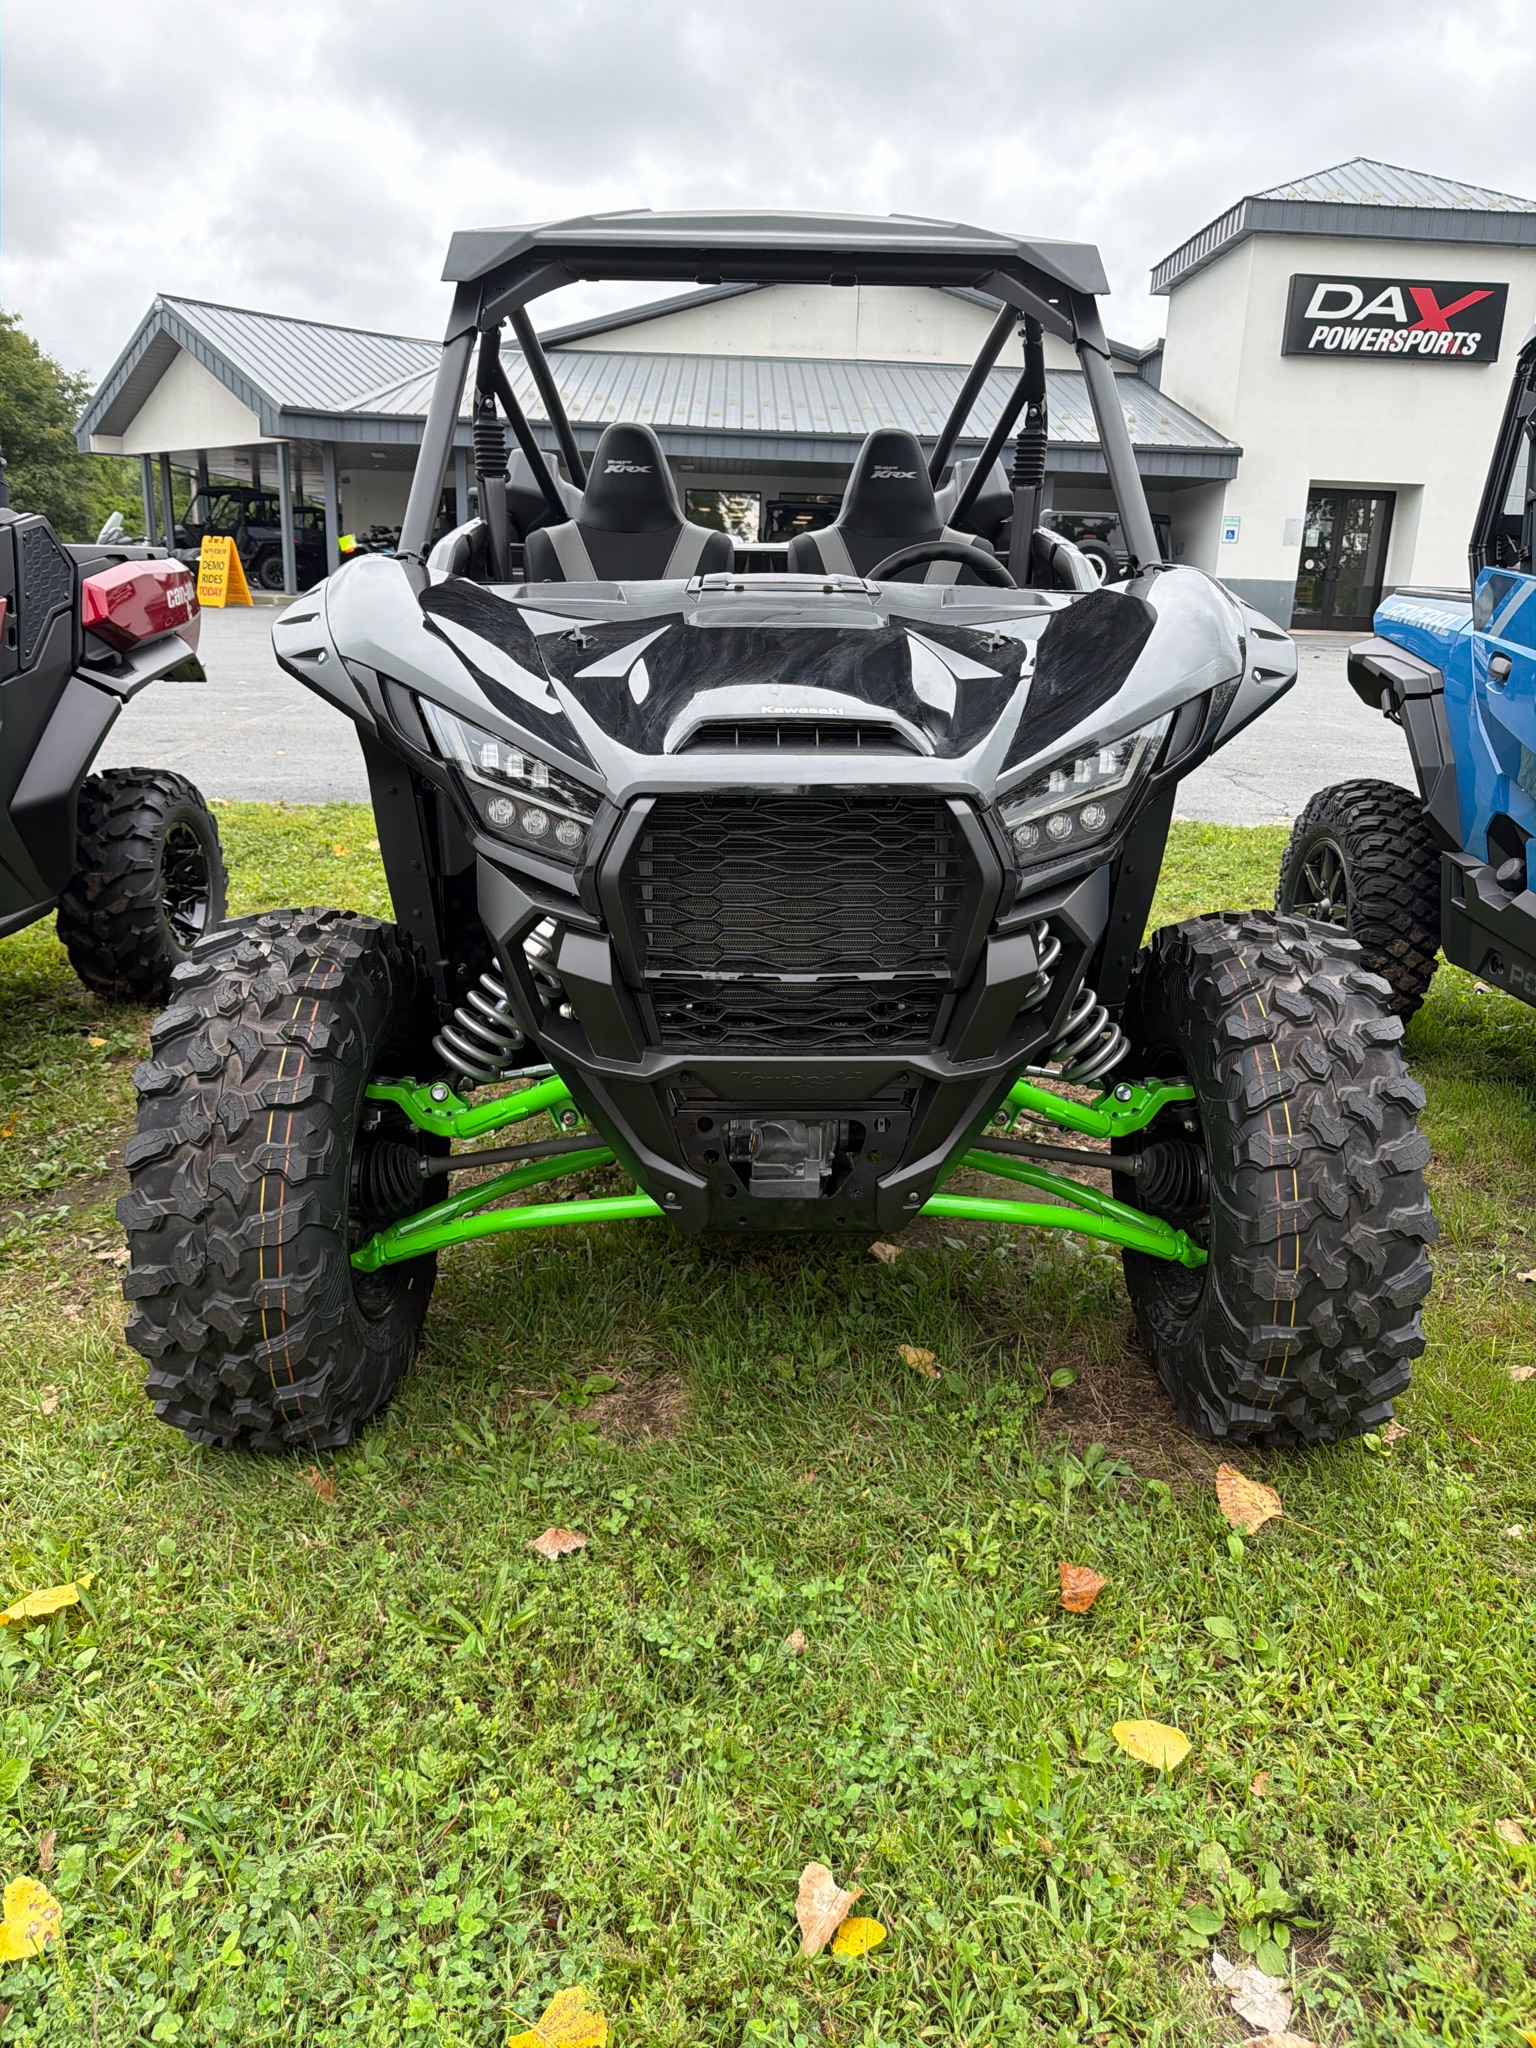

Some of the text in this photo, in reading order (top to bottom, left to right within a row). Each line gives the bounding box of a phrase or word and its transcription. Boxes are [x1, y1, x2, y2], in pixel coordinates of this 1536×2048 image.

[1304, 283, 1495, 331] DAX
[1308, 325, 1481, 356] POWERSPORTS
[604, 465, 652, 473] KRX
[870, 471, 918, 479] KRX
[202, 560, 225, 571] DEMO
[201, 574, 223, 585] RIDES
[199, 586, 223, 597] TODAY
[1382, 603, 1462, 637] GENERAL
[761, 706, 844, 716] Kawasaki
